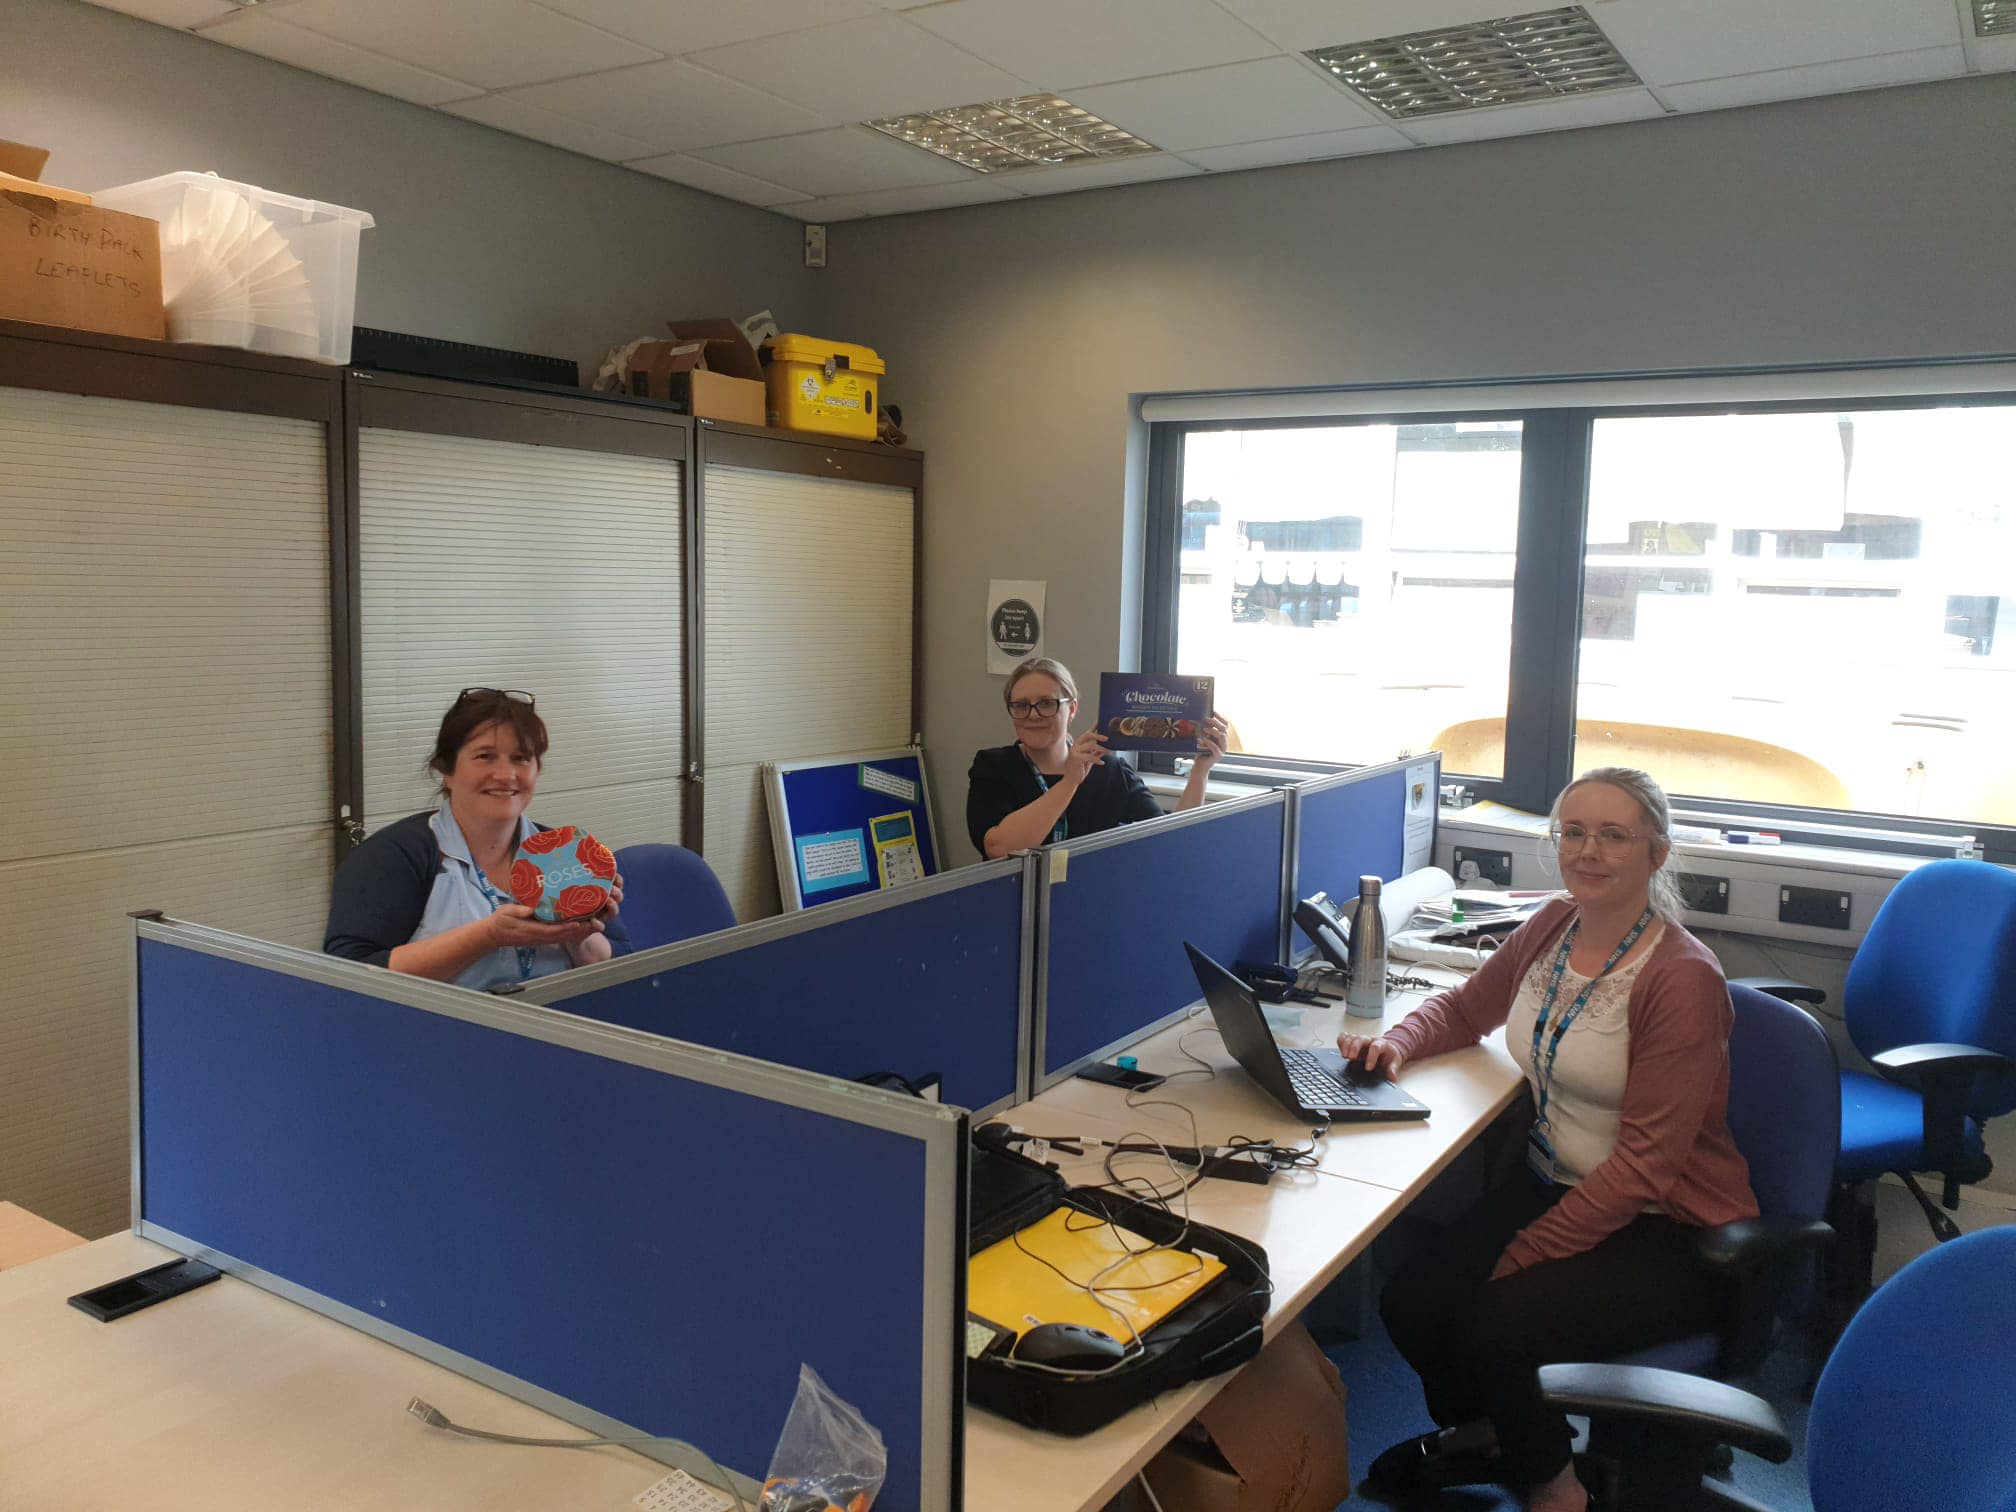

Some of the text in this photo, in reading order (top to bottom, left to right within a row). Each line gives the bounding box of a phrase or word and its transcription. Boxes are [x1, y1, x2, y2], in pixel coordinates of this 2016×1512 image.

[100, 228, 145, 261] PACK
[35, 257, 142, 297] LEAFLETS
[1196, 681, 1208, 690] 12
[1125, 690, 1187, 704] Chocolate
[536, 863, 593, 888] ROSES
[1566, 1003, 1582, 1019] NHS
